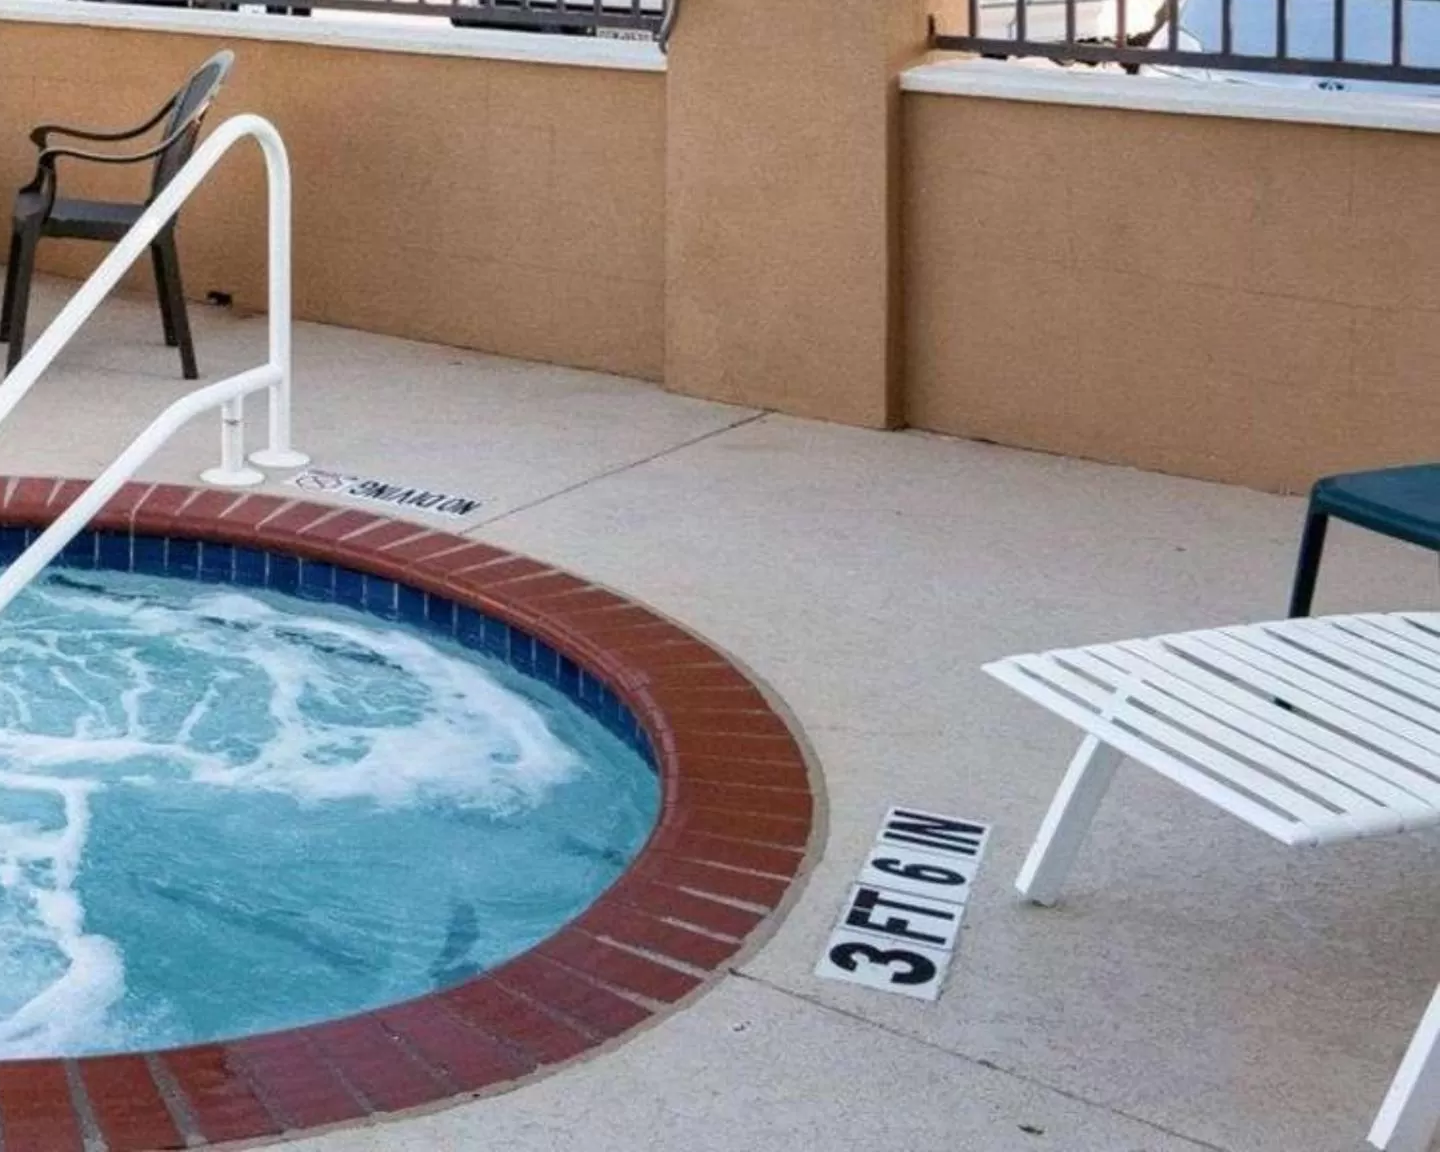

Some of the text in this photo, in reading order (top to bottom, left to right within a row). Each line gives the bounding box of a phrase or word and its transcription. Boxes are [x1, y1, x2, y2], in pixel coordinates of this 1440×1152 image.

[349, 480, 482, 515] NO DIVING
[829, 809, 986, 986] 3 FT 6 IN
